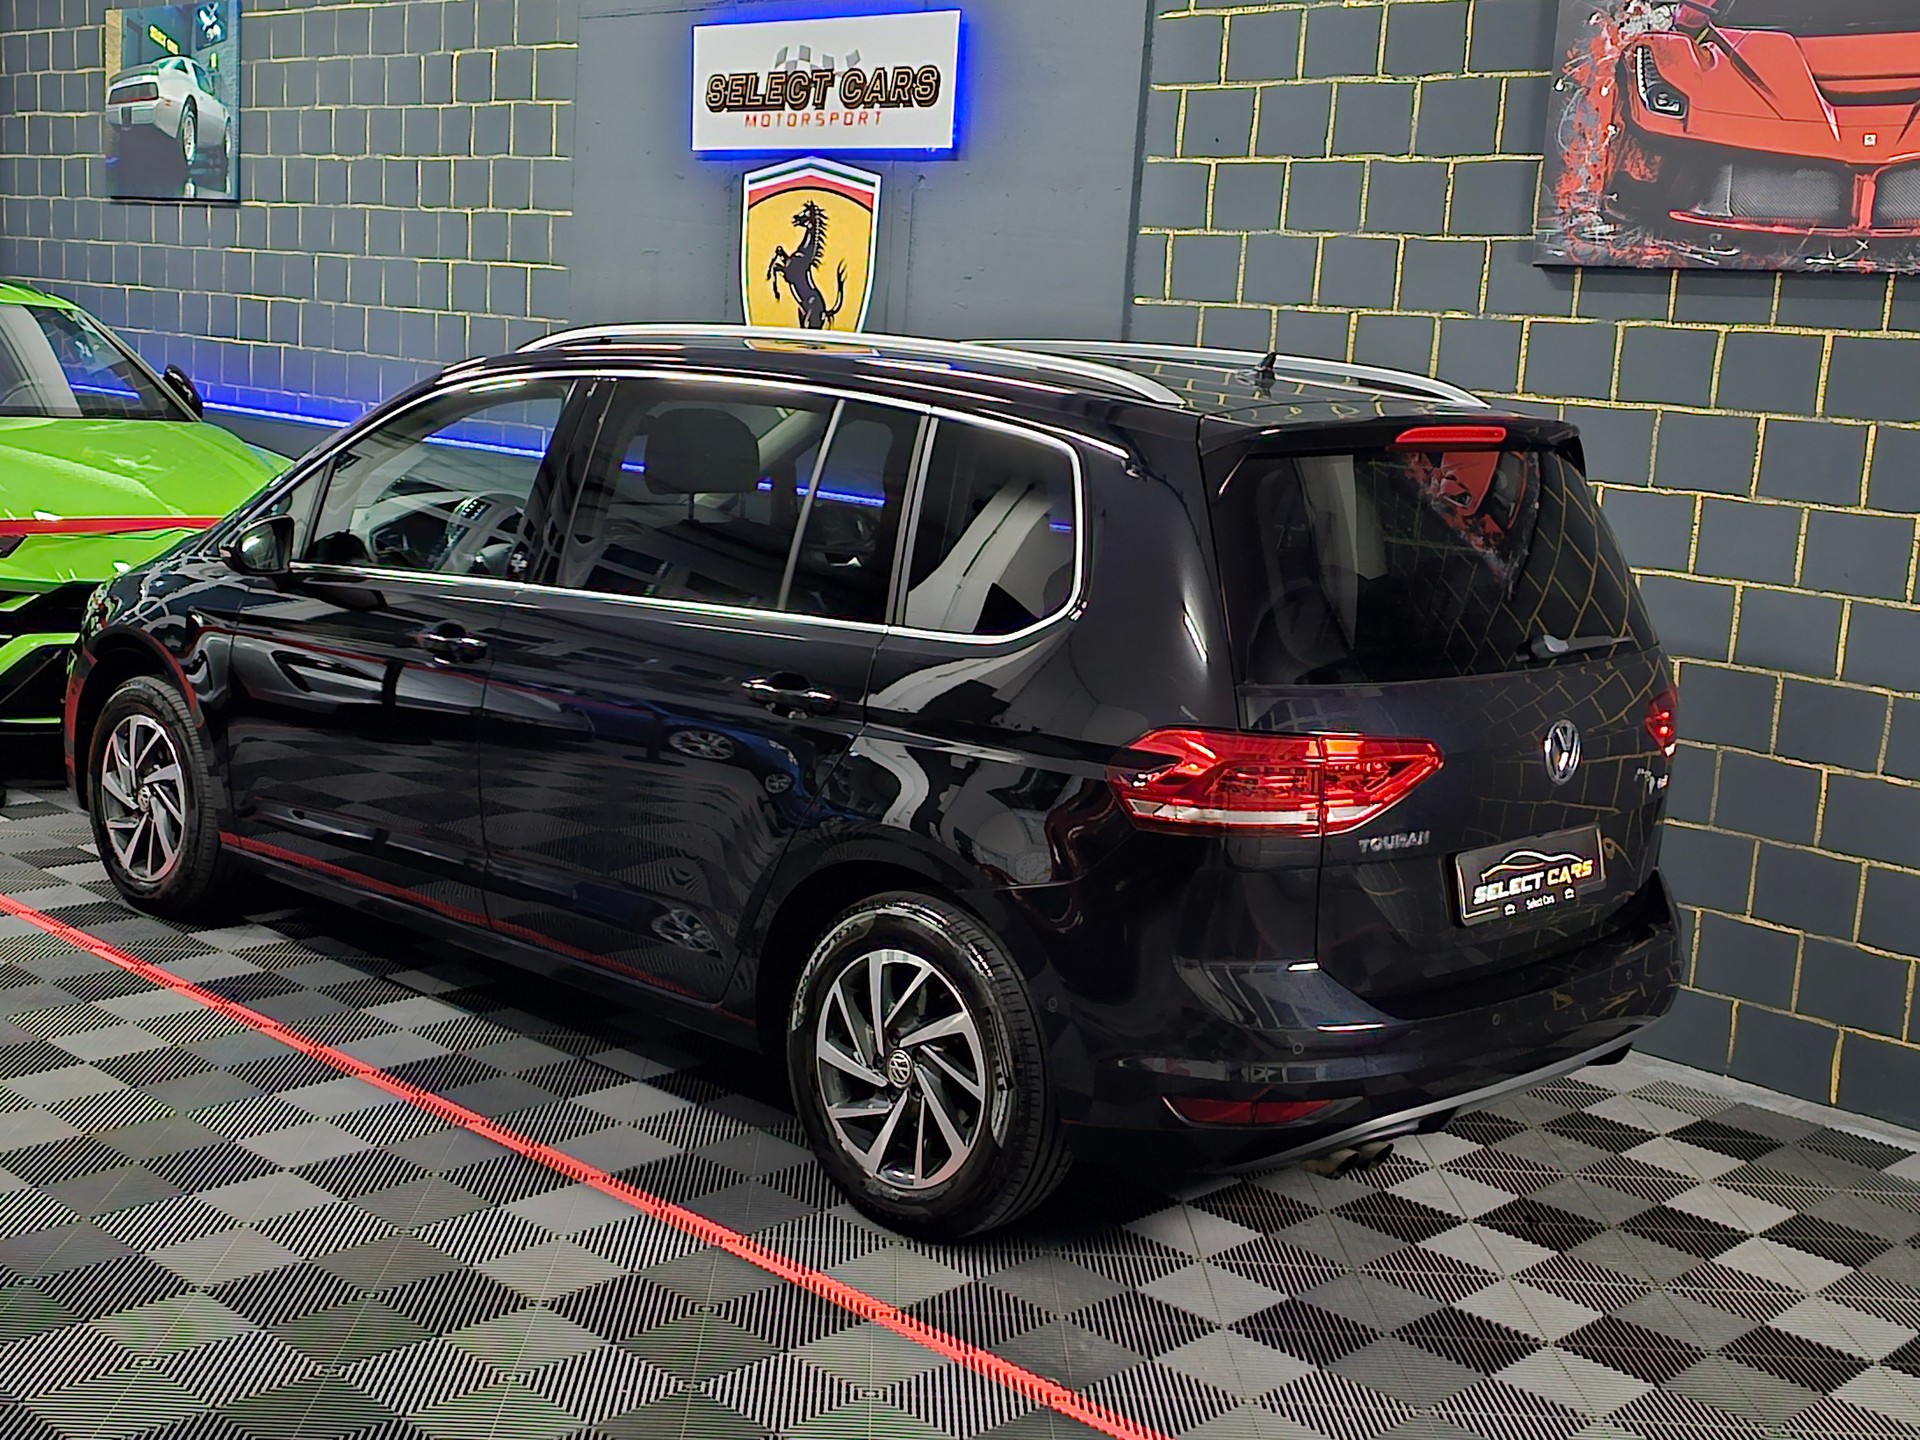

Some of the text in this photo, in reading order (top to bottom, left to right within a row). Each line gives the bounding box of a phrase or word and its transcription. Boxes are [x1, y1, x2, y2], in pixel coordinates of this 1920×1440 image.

[706, 64, 942, 112] SELECT CARS
[743, 111, 882, 128] MOTORSPORT
[1358, 830, 1431, 854] TOURAN
[1473, 859, 1594, 905] SELECT CARS
